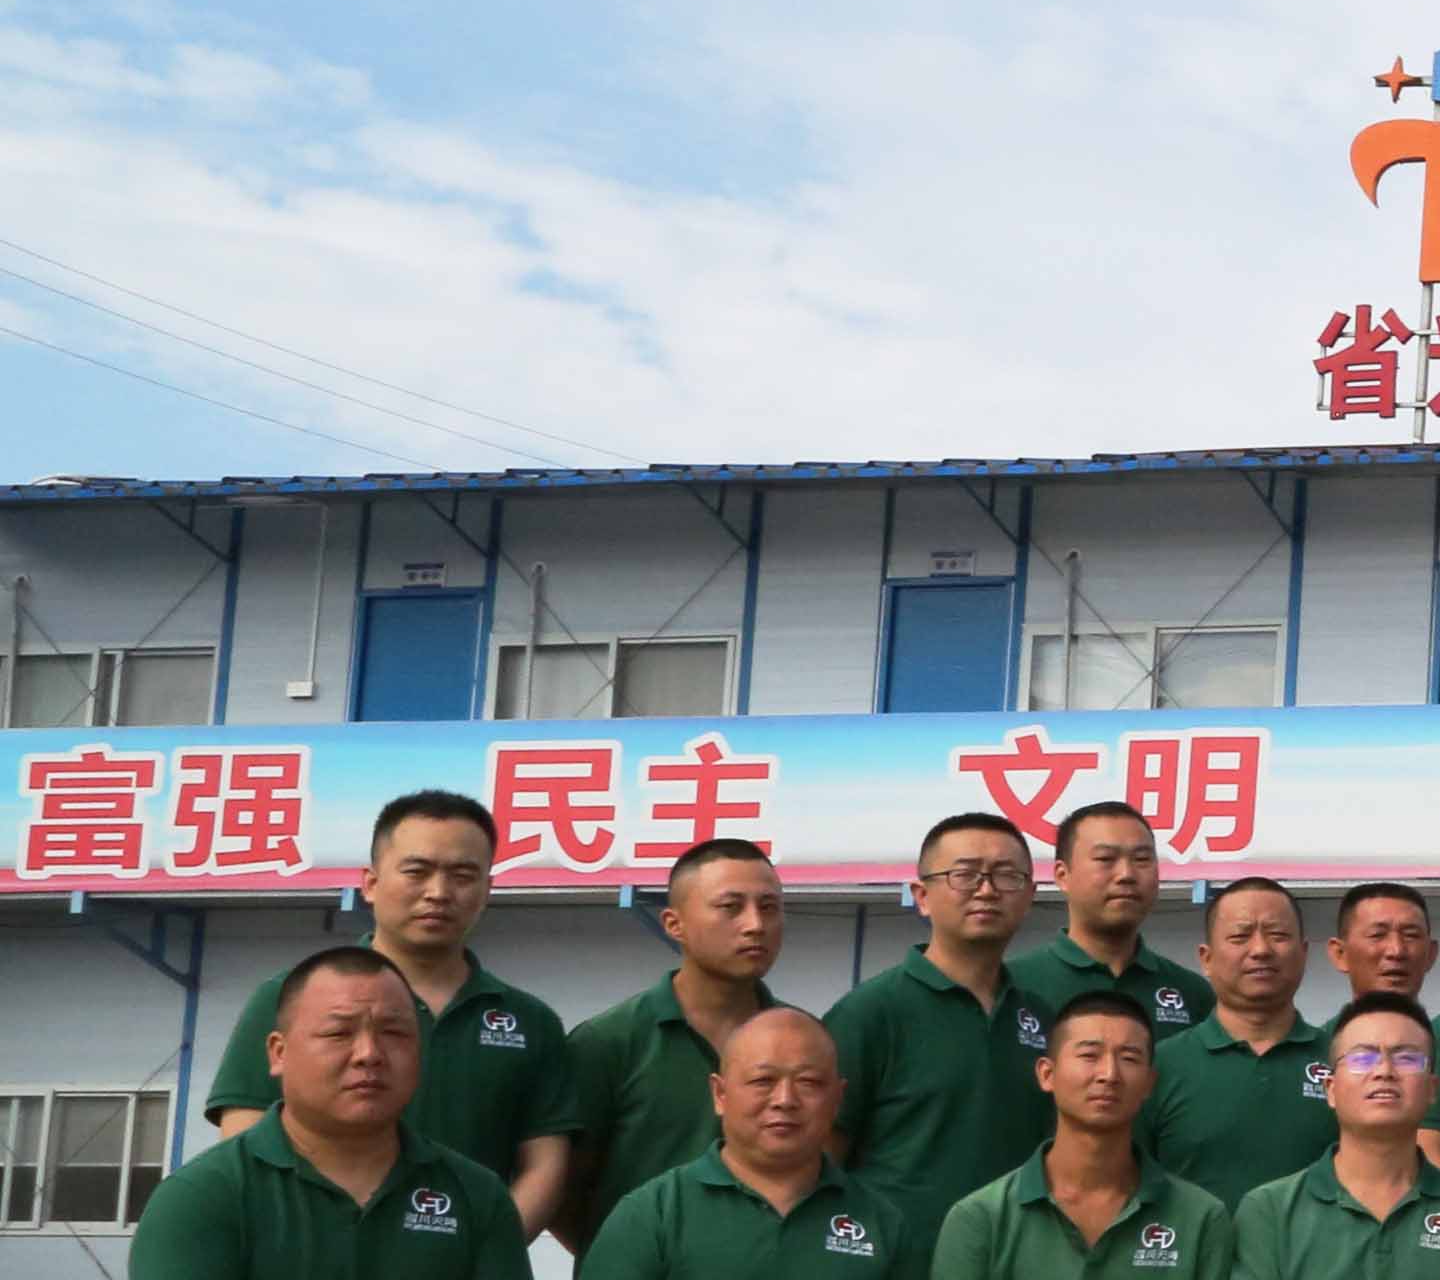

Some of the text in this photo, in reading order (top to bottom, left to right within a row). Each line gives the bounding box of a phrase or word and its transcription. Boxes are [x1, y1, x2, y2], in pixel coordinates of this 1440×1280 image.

[26, 751, 304, 872] 富强
[490, 740, 772, 866] 民主
[958, 733, 1261, 855] 文明
